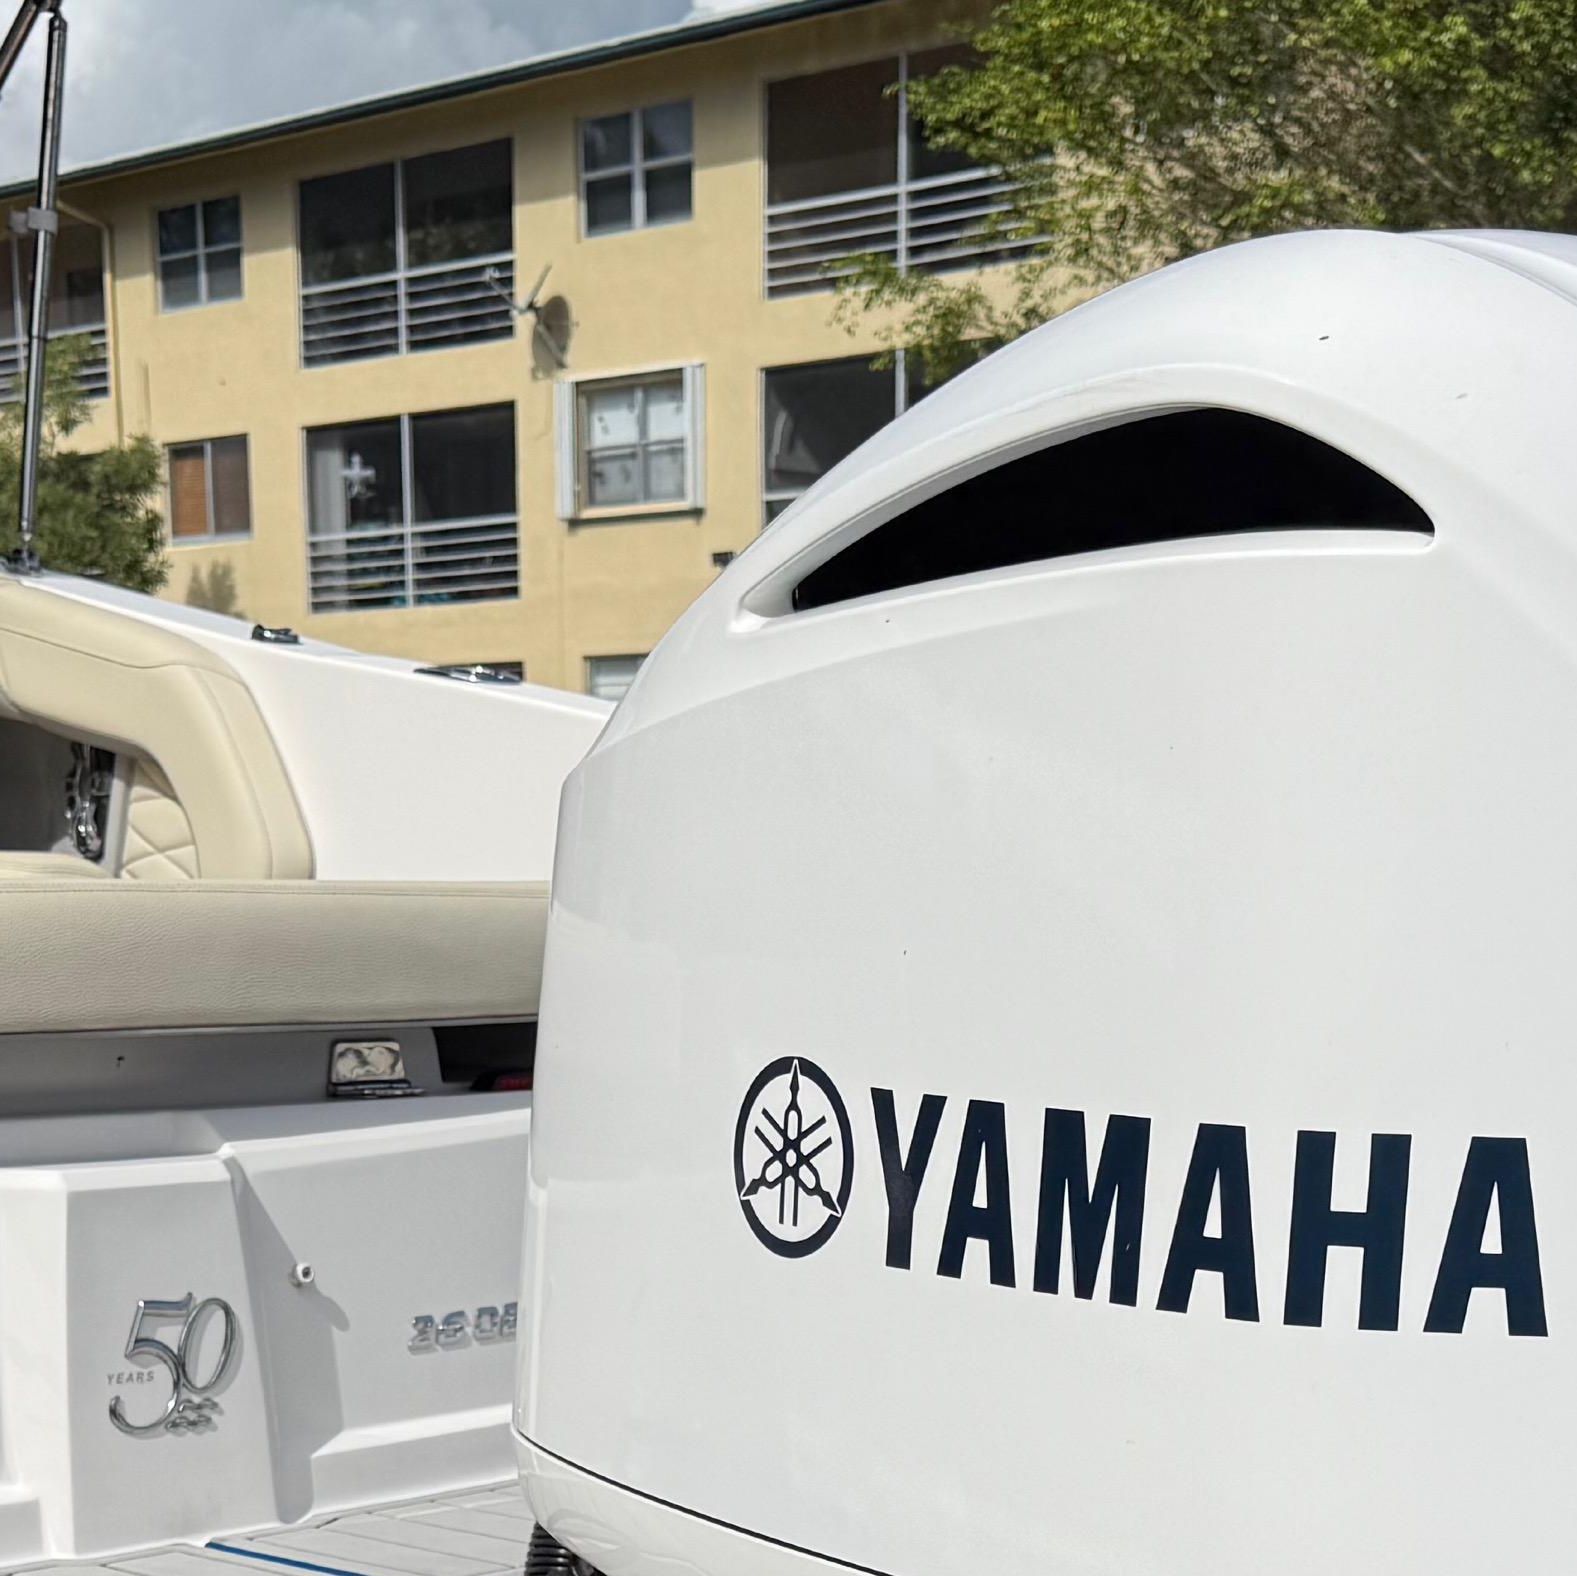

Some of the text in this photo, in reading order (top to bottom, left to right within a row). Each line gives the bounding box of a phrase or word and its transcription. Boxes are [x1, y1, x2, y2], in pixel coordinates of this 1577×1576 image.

[870, 1086, 1549, 1338] YAMAHA
[107, 1371, 155, 1385] YEARS
[108, 1292, 237, 1435] 50
